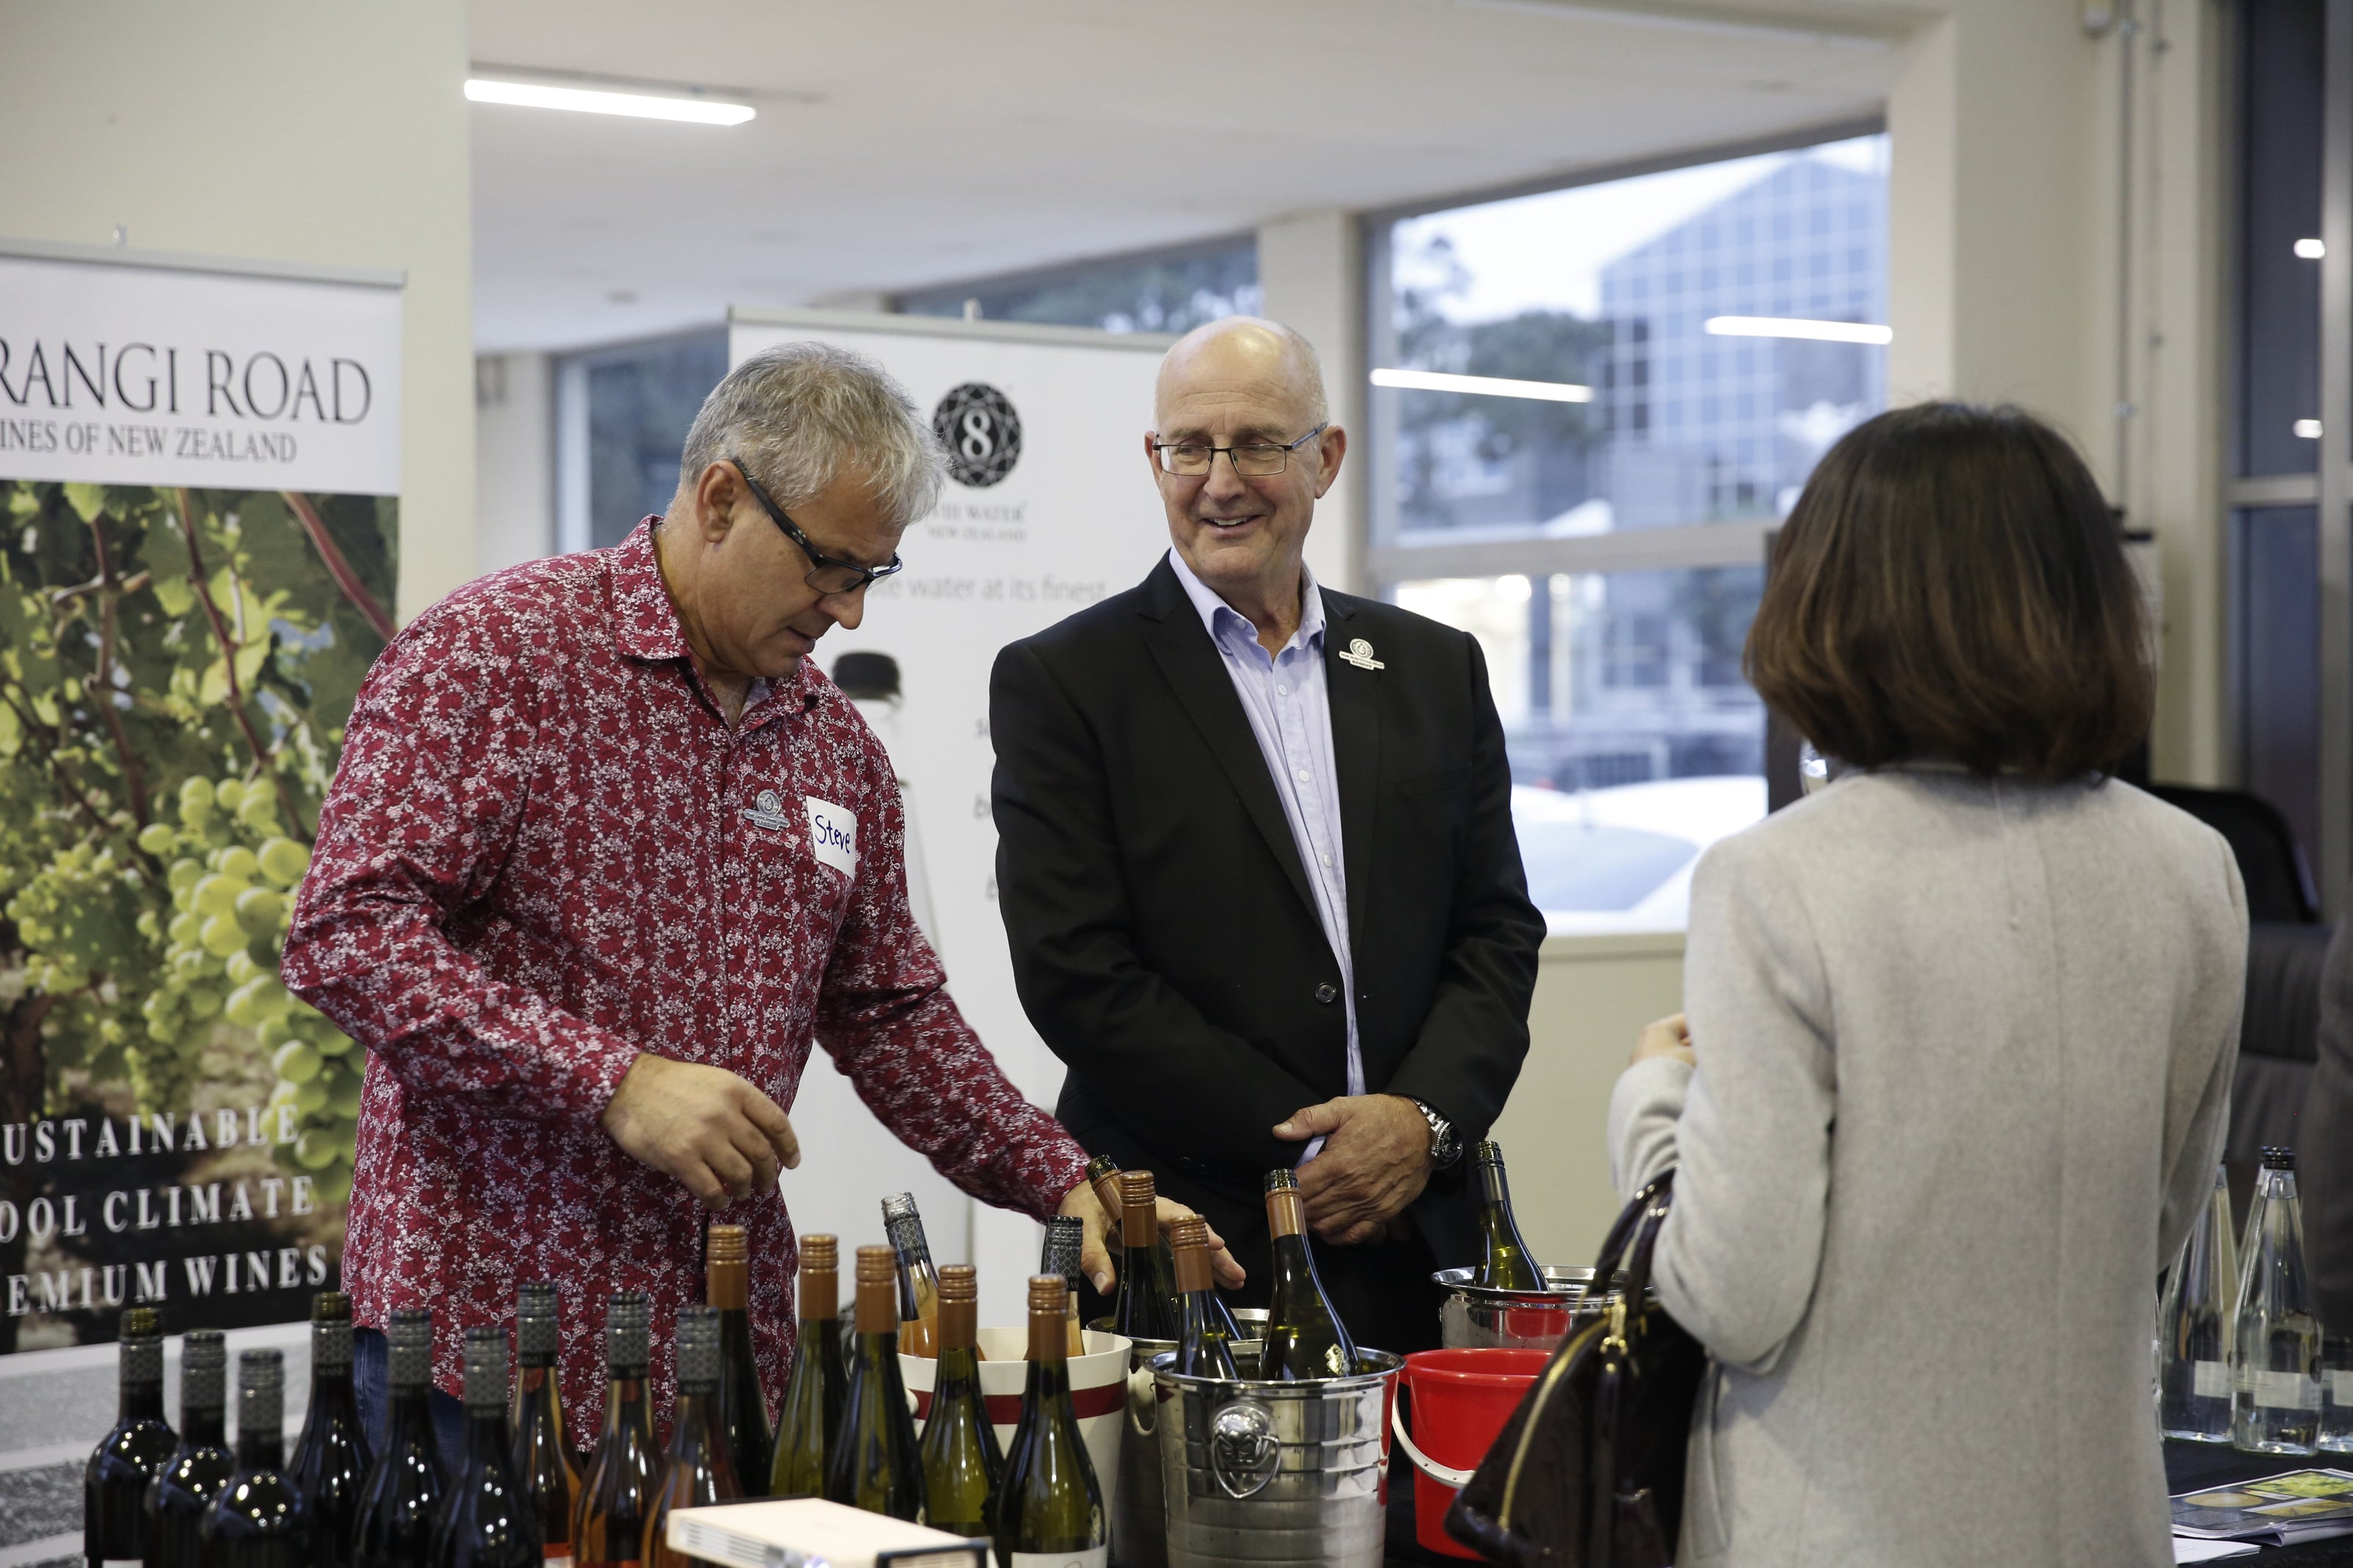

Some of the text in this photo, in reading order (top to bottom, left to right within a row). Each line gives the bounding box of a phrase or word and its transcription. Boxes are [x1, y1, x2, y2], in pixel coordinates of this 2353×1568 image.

[204, 349, 372, 425] ROAD
[65, 420, 101, 455] OF
[108, 424, 167, 457] NEW
[176, 427, 296, 463] ZEALAND
[961, 409, 993, 462] 8
[907, 576, 975, 601] water
[980, 578, 1003, 601] at
[1010, 575, 1037, 602] its
[1041, 573, 1106, 602] finest
[815, 815, 851, 853] Steve
[1, 1103, 299, 1167] USTAINABLE
[104, 1176, 313, 1232] CLIMATE
[7, 1245, 327, 1317] EMIUM WINES
